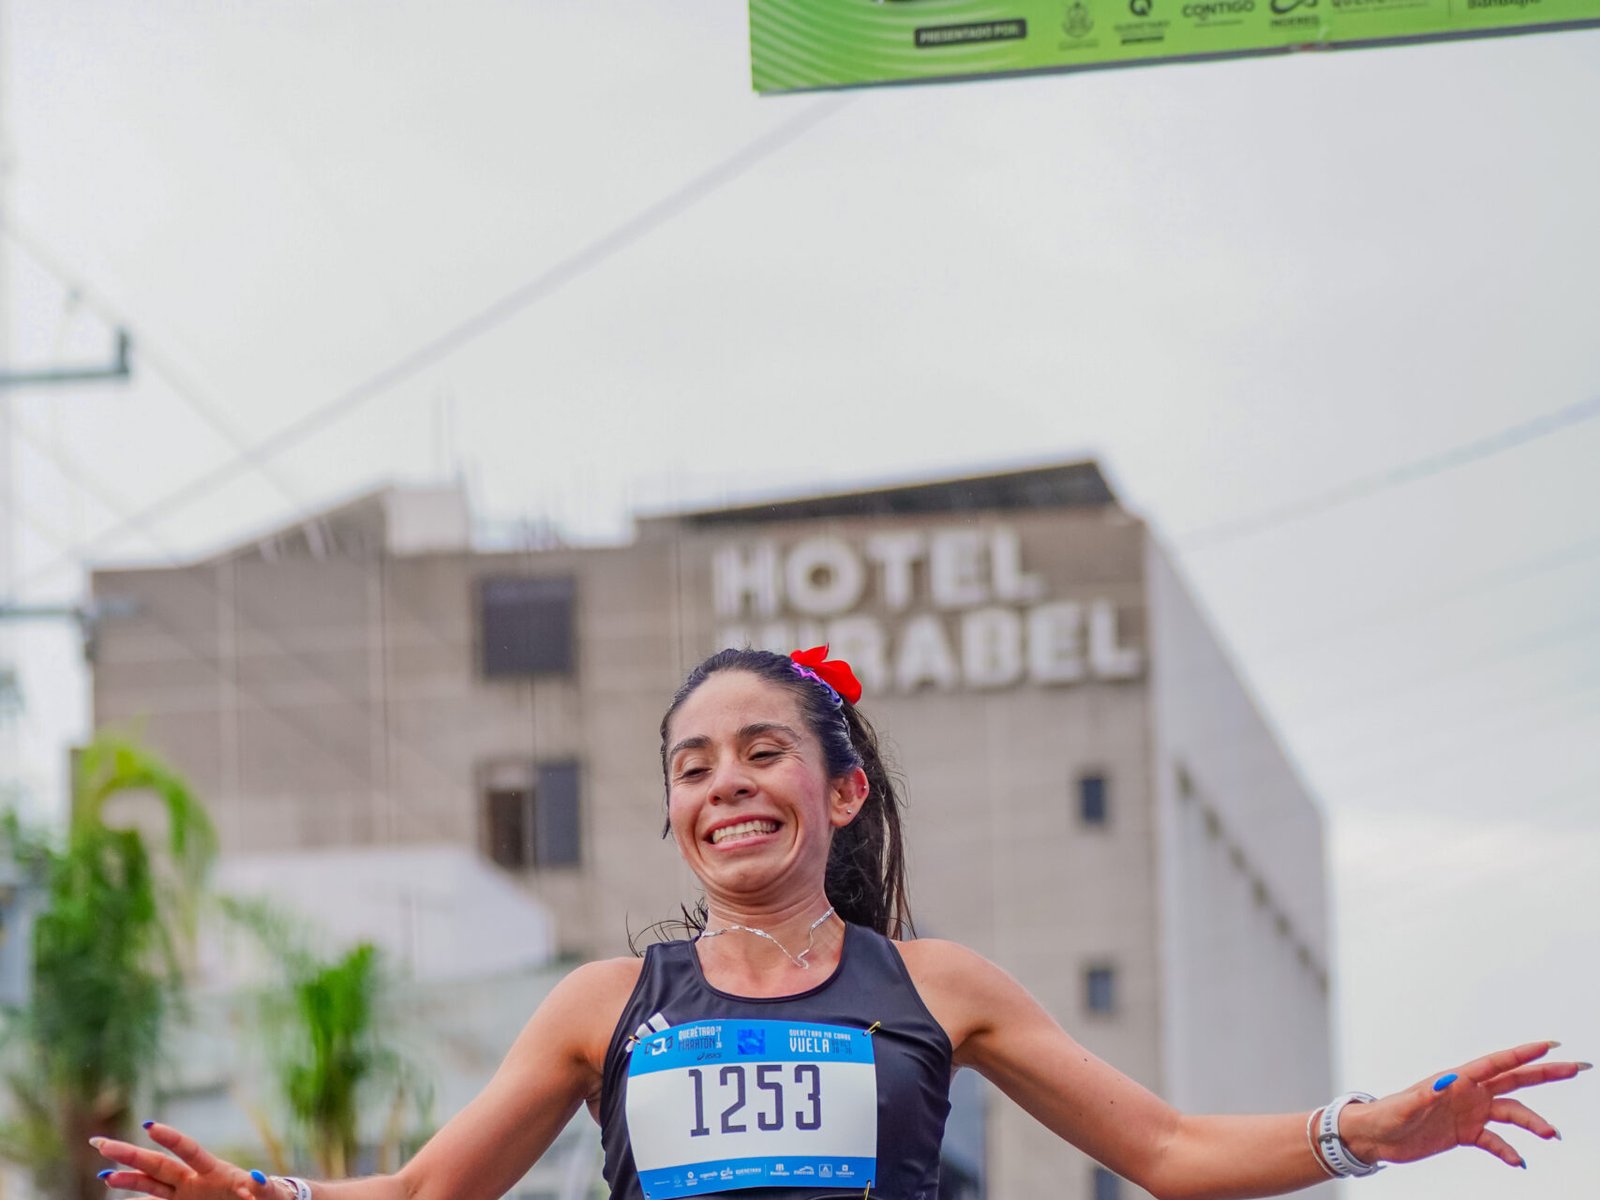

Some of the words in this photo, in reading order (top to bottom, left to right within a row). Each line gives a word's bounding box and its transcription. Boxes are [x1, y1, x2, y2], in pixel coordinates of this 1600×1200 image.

[1182, 0, 1255, 19] CONTIGO
[919, 25, 993, 44] PRESENTADO
[711, 526, 1044, 617] HOTEL
[789, 1037, 829, 1054] VUELA
[688, 1064, 822, 1137] 1253
